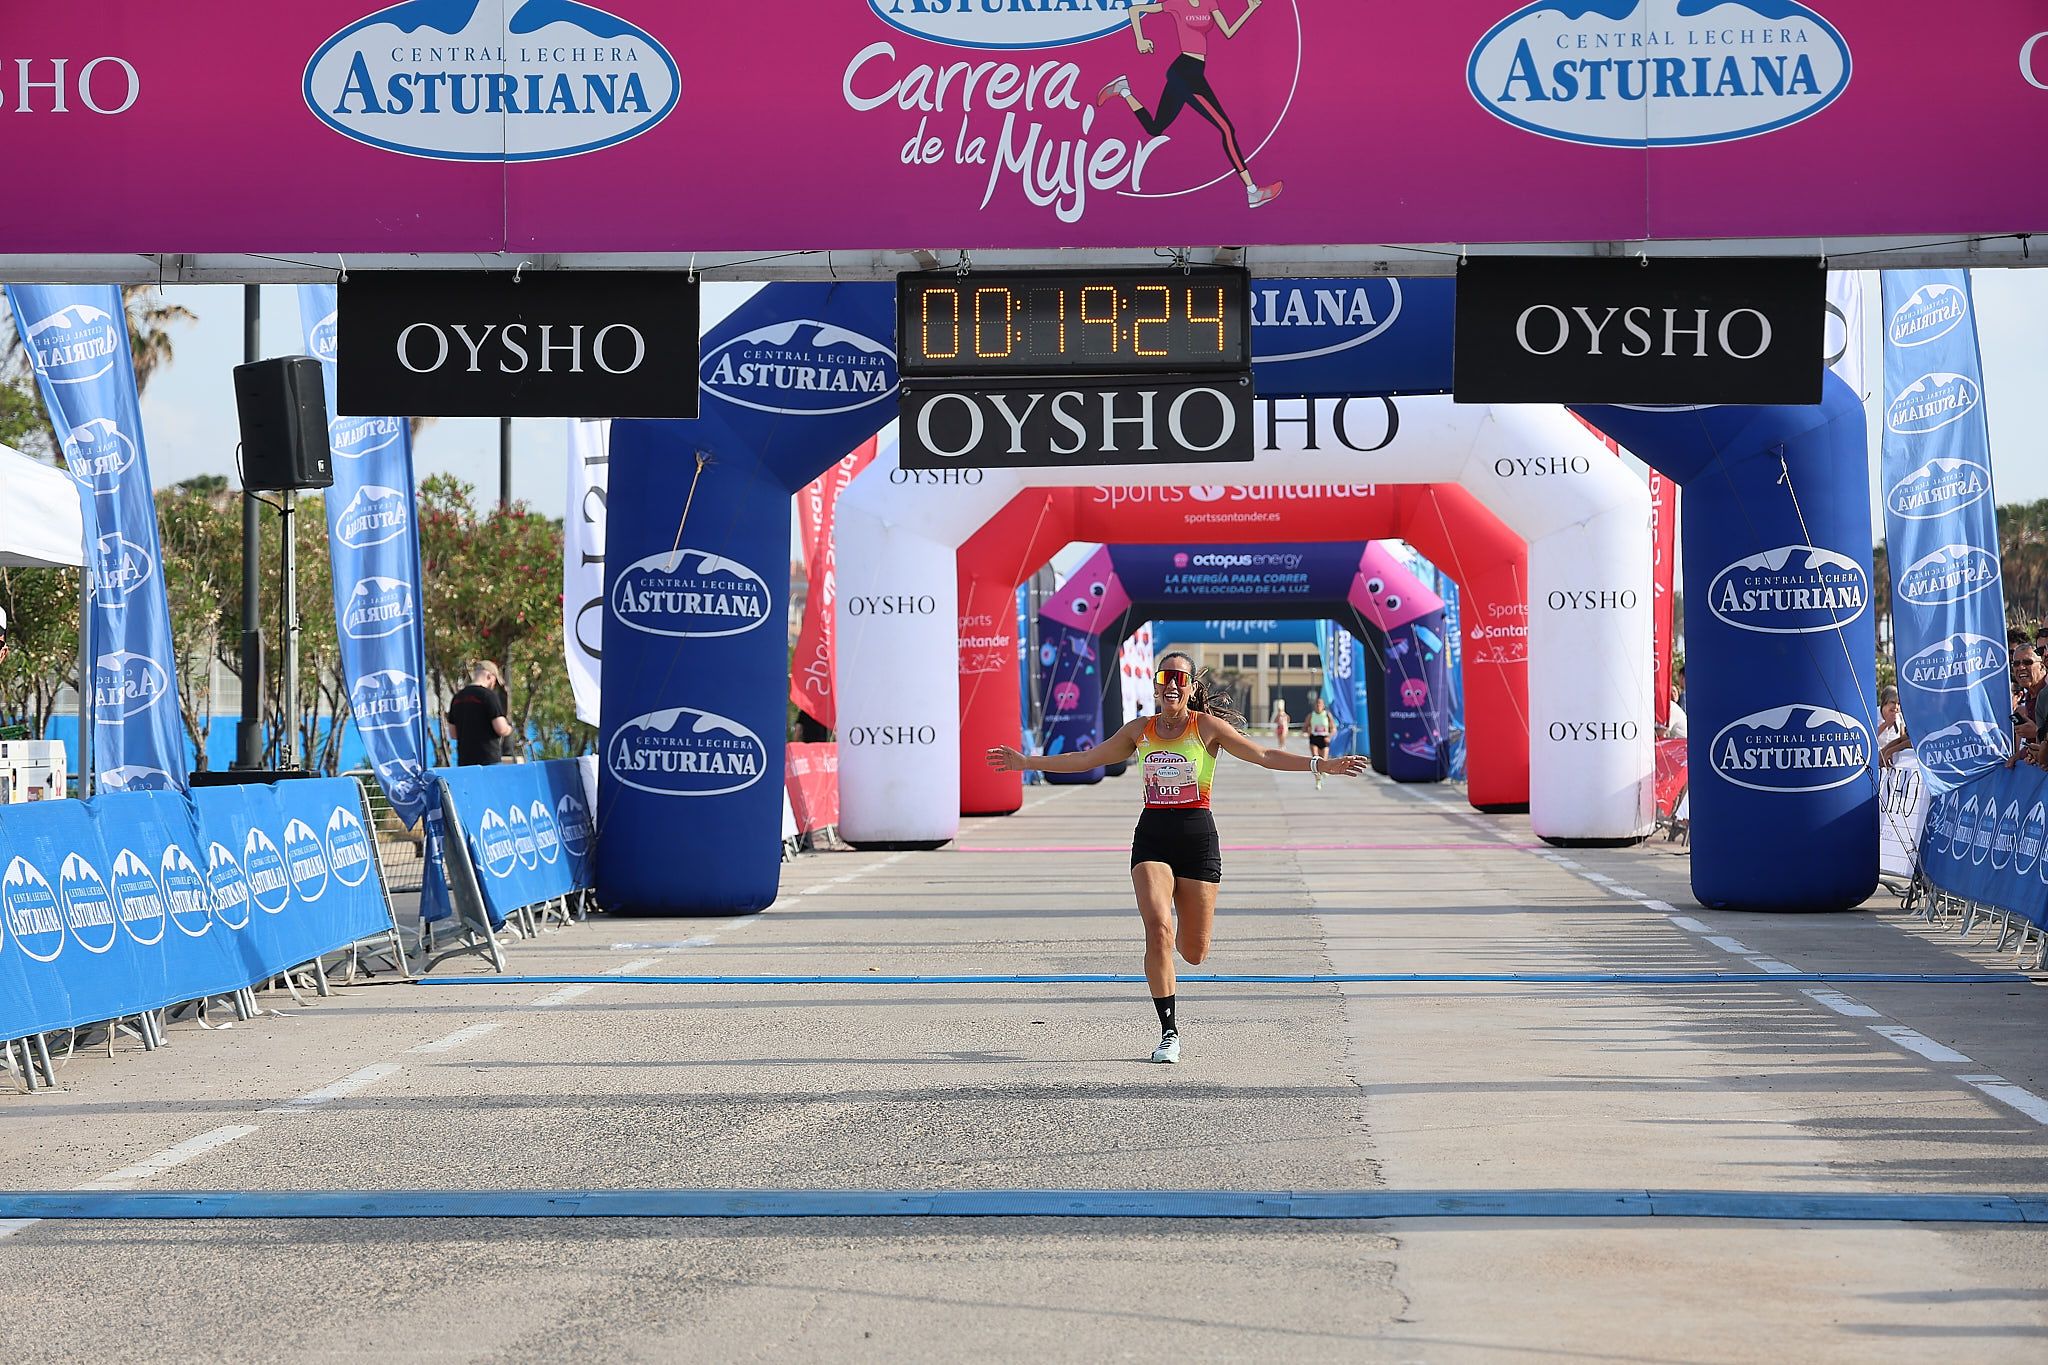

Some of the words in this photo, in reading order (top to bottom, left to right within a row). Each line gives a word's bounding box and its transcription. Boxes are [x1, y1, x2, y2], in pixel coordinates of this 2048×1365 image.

[1557, 32, 1675, 49] CENTRAL
[1688, 29, 1809, 47] LECHERA
[391, 46, 507, 62] CENTRAL
[520, 47, 639, 62] LECHERA
[842, 41, 1081, 112] Carrera
[1498, 38, 1822, 102] ASTURIANA
[0, 56, 140, 115] HO
[333, 50, 652, 115] ASTURIANA
[900, 115, 944, 165] de
[955, 115, 986, 165] la
[979, 104, 1170, 223] Mujer
[921, 285, 1226, 360] 00:19:24
[1515, 304, 1773, 360] OYSHO
[396, 322, 646, 375] OYSHO
[743, 350, 811, 362] CENTRAL
[817, 353, 886, 366] LECHERA
[706, 352, 888, 393] ASTURIANA
[916, 387, 1237, 457] OYSHO
[889, 466, 984, 486] OYSHO
[1494, 455, 1590, 478] OYSHO
[1093, 484, 1184, 509] Sports
[1184, 511, 1281, 524] sportssantander.es
[1192, 552, 1252, 569] octopus
[1253, 553, 1304, 570] energy
[640, 578, 697, 589] CENTRAL
[702, 580, 758, 592] LECHERA
[1164, 574, 1180, 584] LA
[1181, 572, 1229, 584] ENERGÍA
[1231, 573, 1261, 584] PARA
[1263, 573, 1308, 584] CORRER
[1164, 585, 1173, 594] A
[1174, 585, 1189, 594] LA
[1191, 585, 1253, 594] VELOCIDAD
[1255, 585, 1270, 593] DE
[1272, 585, 1287, 593] LA
[1288, 584, 1311, 593] LUZ
[1744, 576, 1805, 586] CENTRAL
[1810, 573, 1859, 584] LECHERA
[619, 580, 762, 618] ASTURIANA
[848, 594, 936, 617] OYSHO
[1547, 588, 1638, 611] OYSHO
[1718, 579, 1863, 613] ASTURIANA
[959, 614, 993, 629] ports
[1488, 603, 1529, 619] Sports
[959, 634, 1010, 648] ntander
[636, 736, 692, 747] CENTRAL
[697, 738, 753, 750] LECHERA
[848, 724, 936, 748] OYSHO
[1548, 720, 1638, 743] OYSHO
[1745, 735, 1806, 745] CENTRAL
[1811, 731, 1861, 743] LECHERA
[614, 738, 757, 775] ASTURIANA
[1719, 737, 1865, 770] ASTURIANA
[1159, 786, 1180, 795] 016
